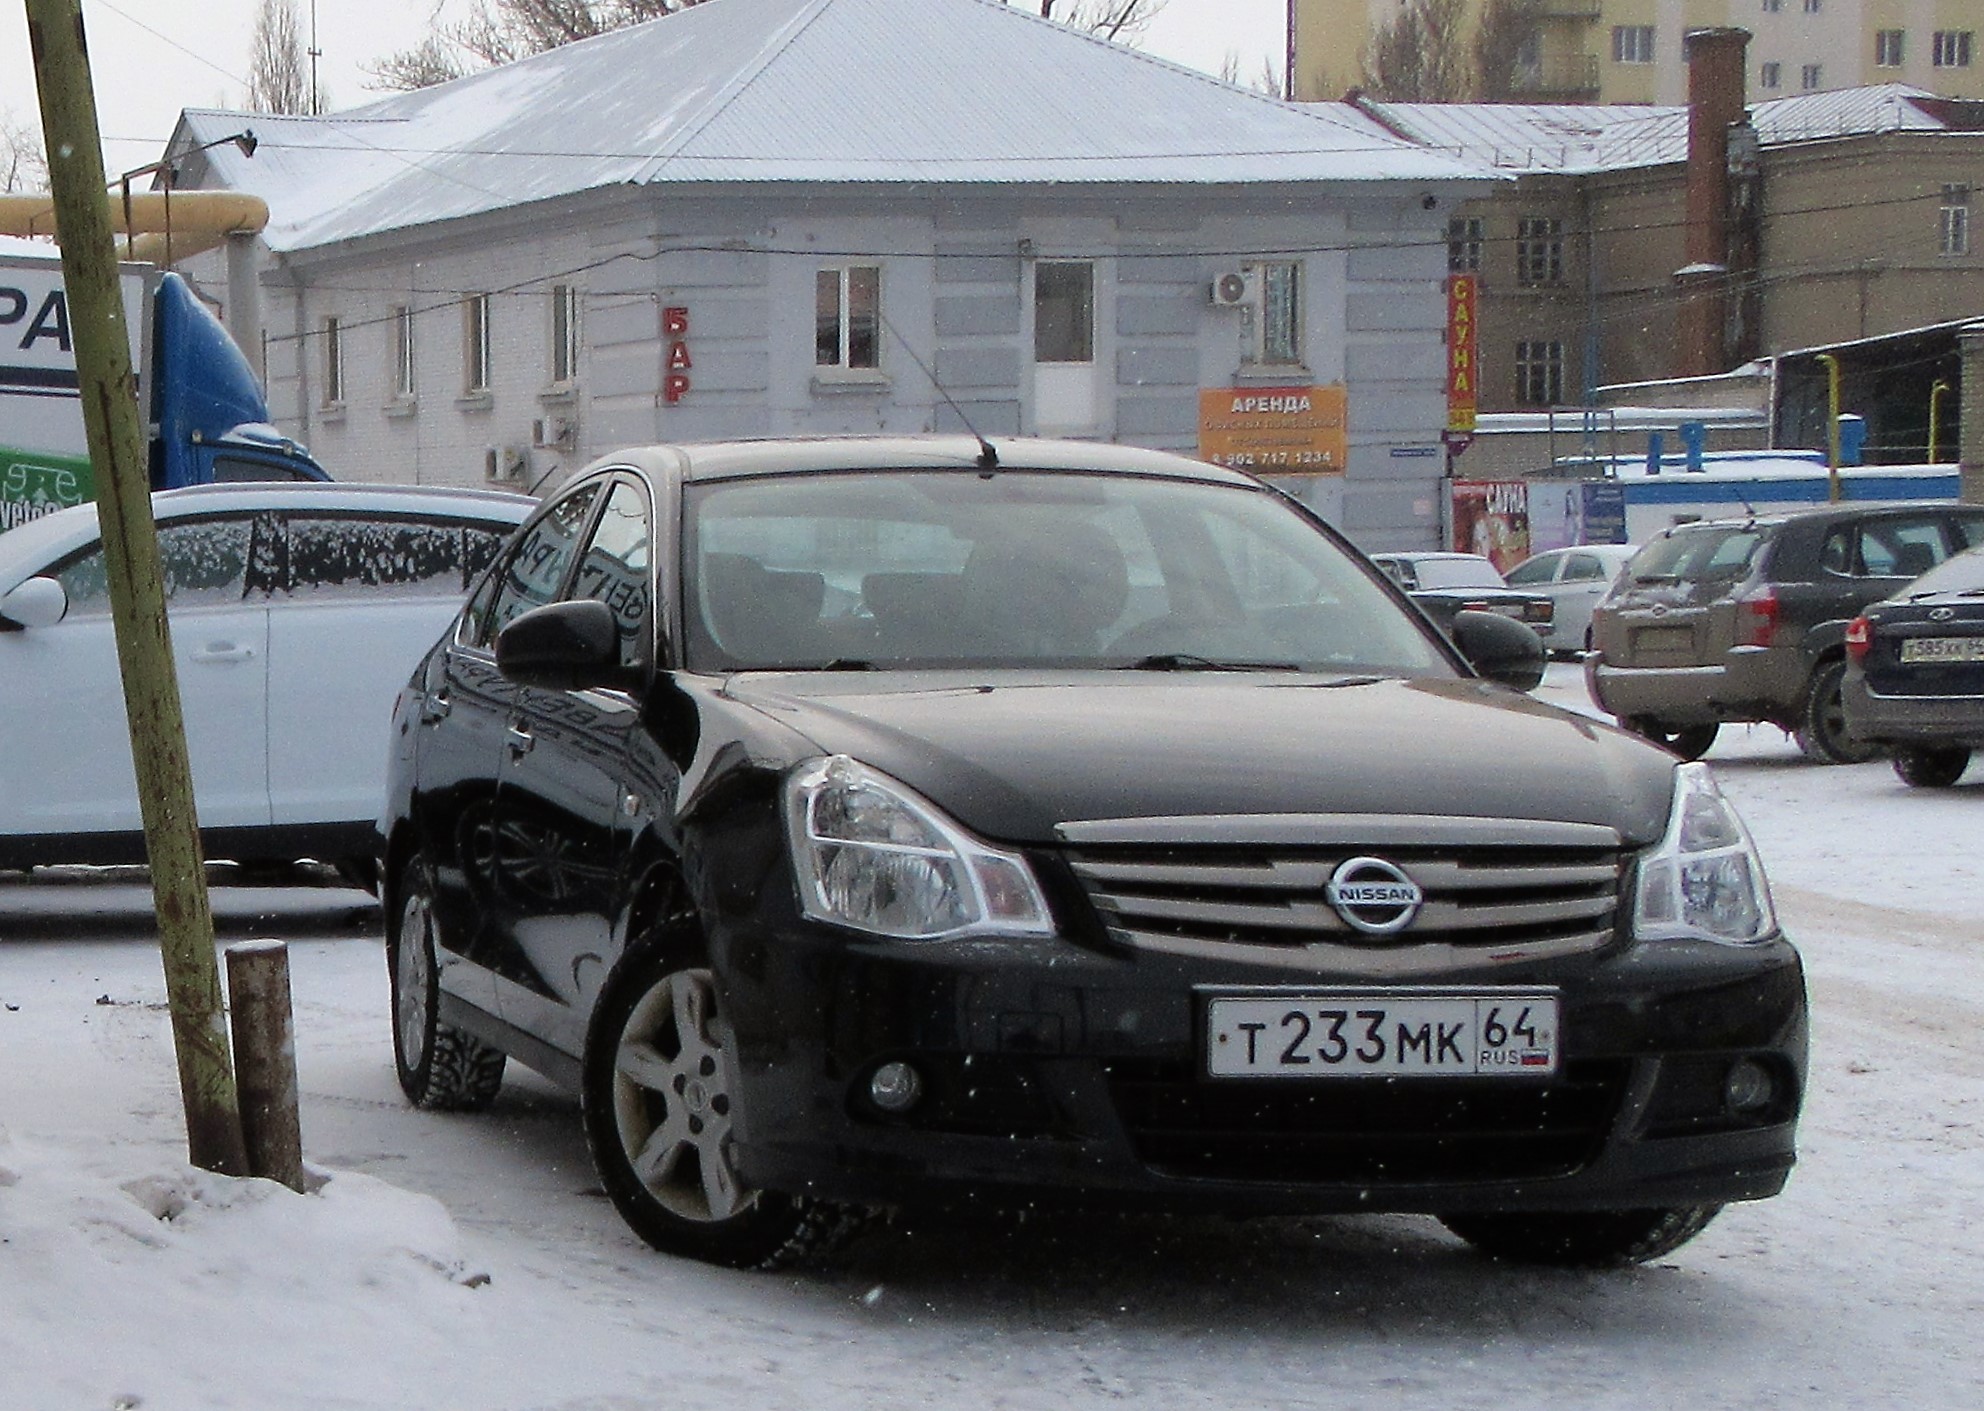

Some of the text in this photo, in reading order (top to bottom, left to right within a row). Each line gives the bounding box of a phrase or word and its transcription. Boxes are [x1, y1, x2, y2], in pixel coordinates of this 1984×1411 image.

[1454, 279, 1469, 391] САУНА
[663, 307, 692, 402] БАР
[1231, 396, 1312, 414] АРЕНДА
[1226, 453, 1255, 465] 902
[1261, 452, 1288, 464] 717
[1296, 451, 1331, 463] 1234
[1338, 888, 1415, 900] NISSAN
[1484, 1007, 1536, 1048] 64
[1480, 1051, 1519, 1065] RUS
